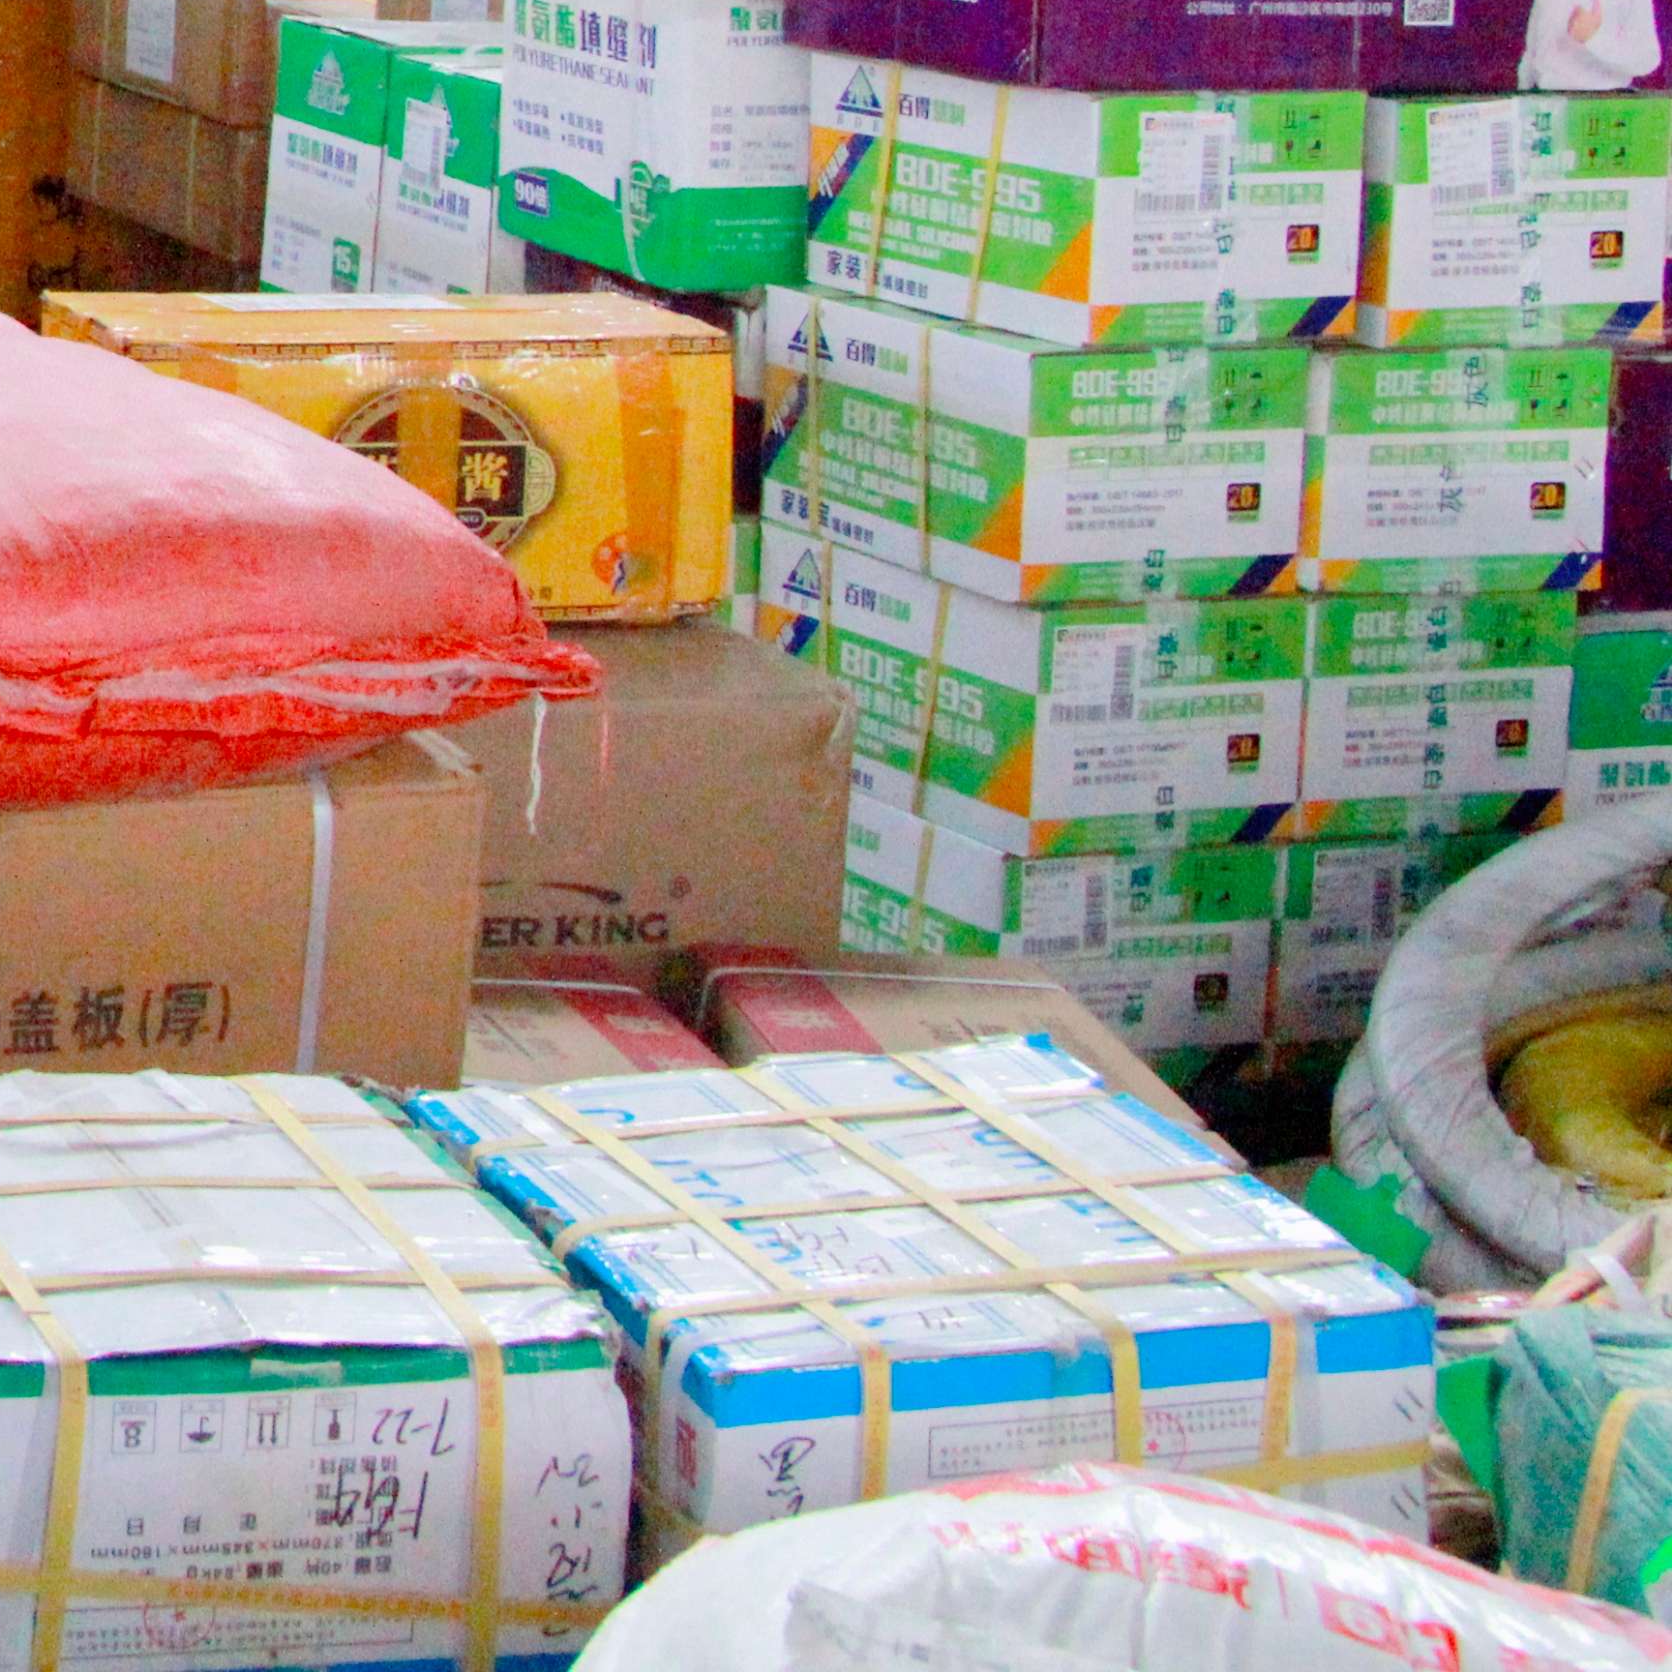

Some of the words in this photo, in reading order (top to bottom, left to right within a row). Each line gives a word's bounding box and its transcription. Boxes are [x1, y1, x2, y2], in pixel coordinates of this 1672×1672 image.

[460, 450, 508, 503] 酱
[479, 918, 544, 949] ER
[557, 913, 670, 947] KING
[125, 1516, 145, 1536] 日
[183, 1515, 202, 1534] 月
